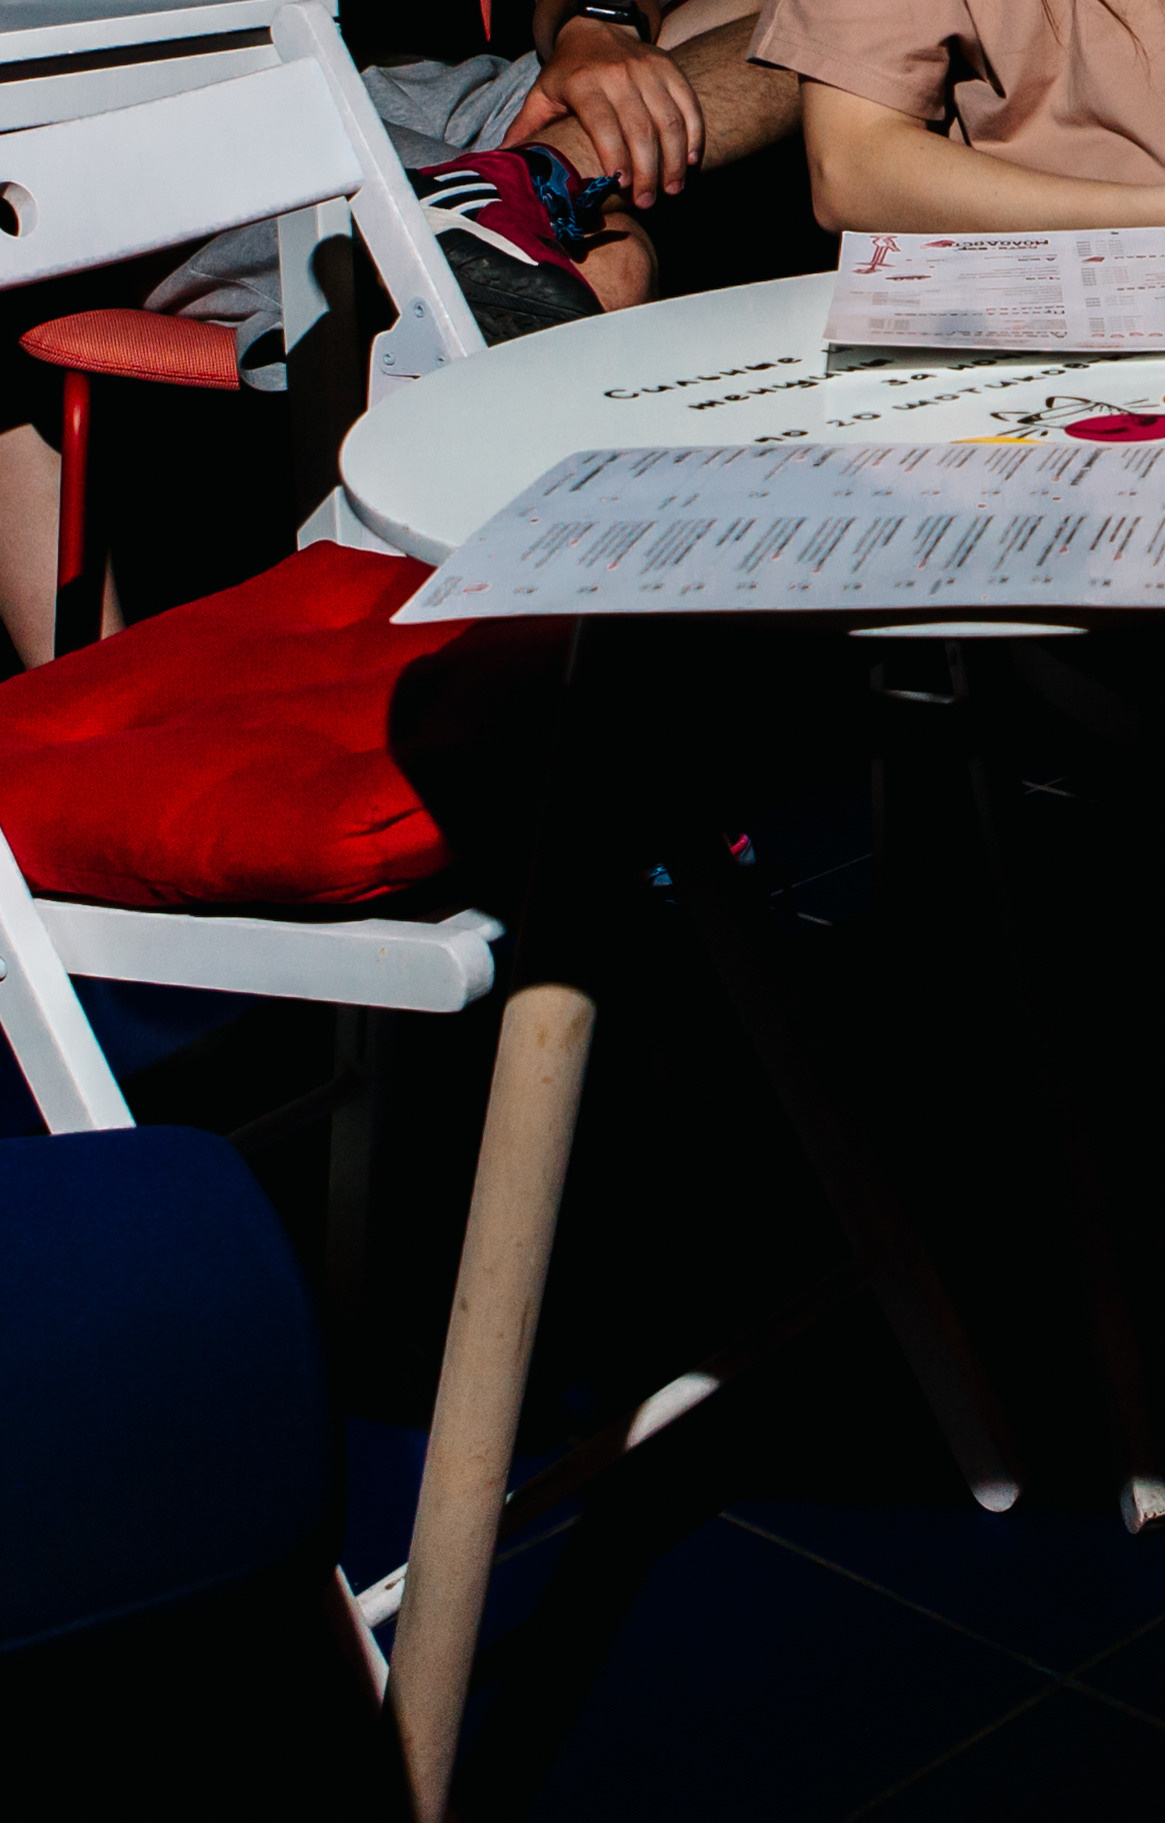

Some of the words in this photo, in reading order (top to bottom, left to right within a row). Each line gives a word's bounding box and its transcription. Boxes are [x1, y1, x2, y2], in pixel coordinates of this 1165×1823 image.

[603, 356, 803, 400] Сильные
[687, 357, 894, 411] женщины
[826, 412, 882, 428] 20
